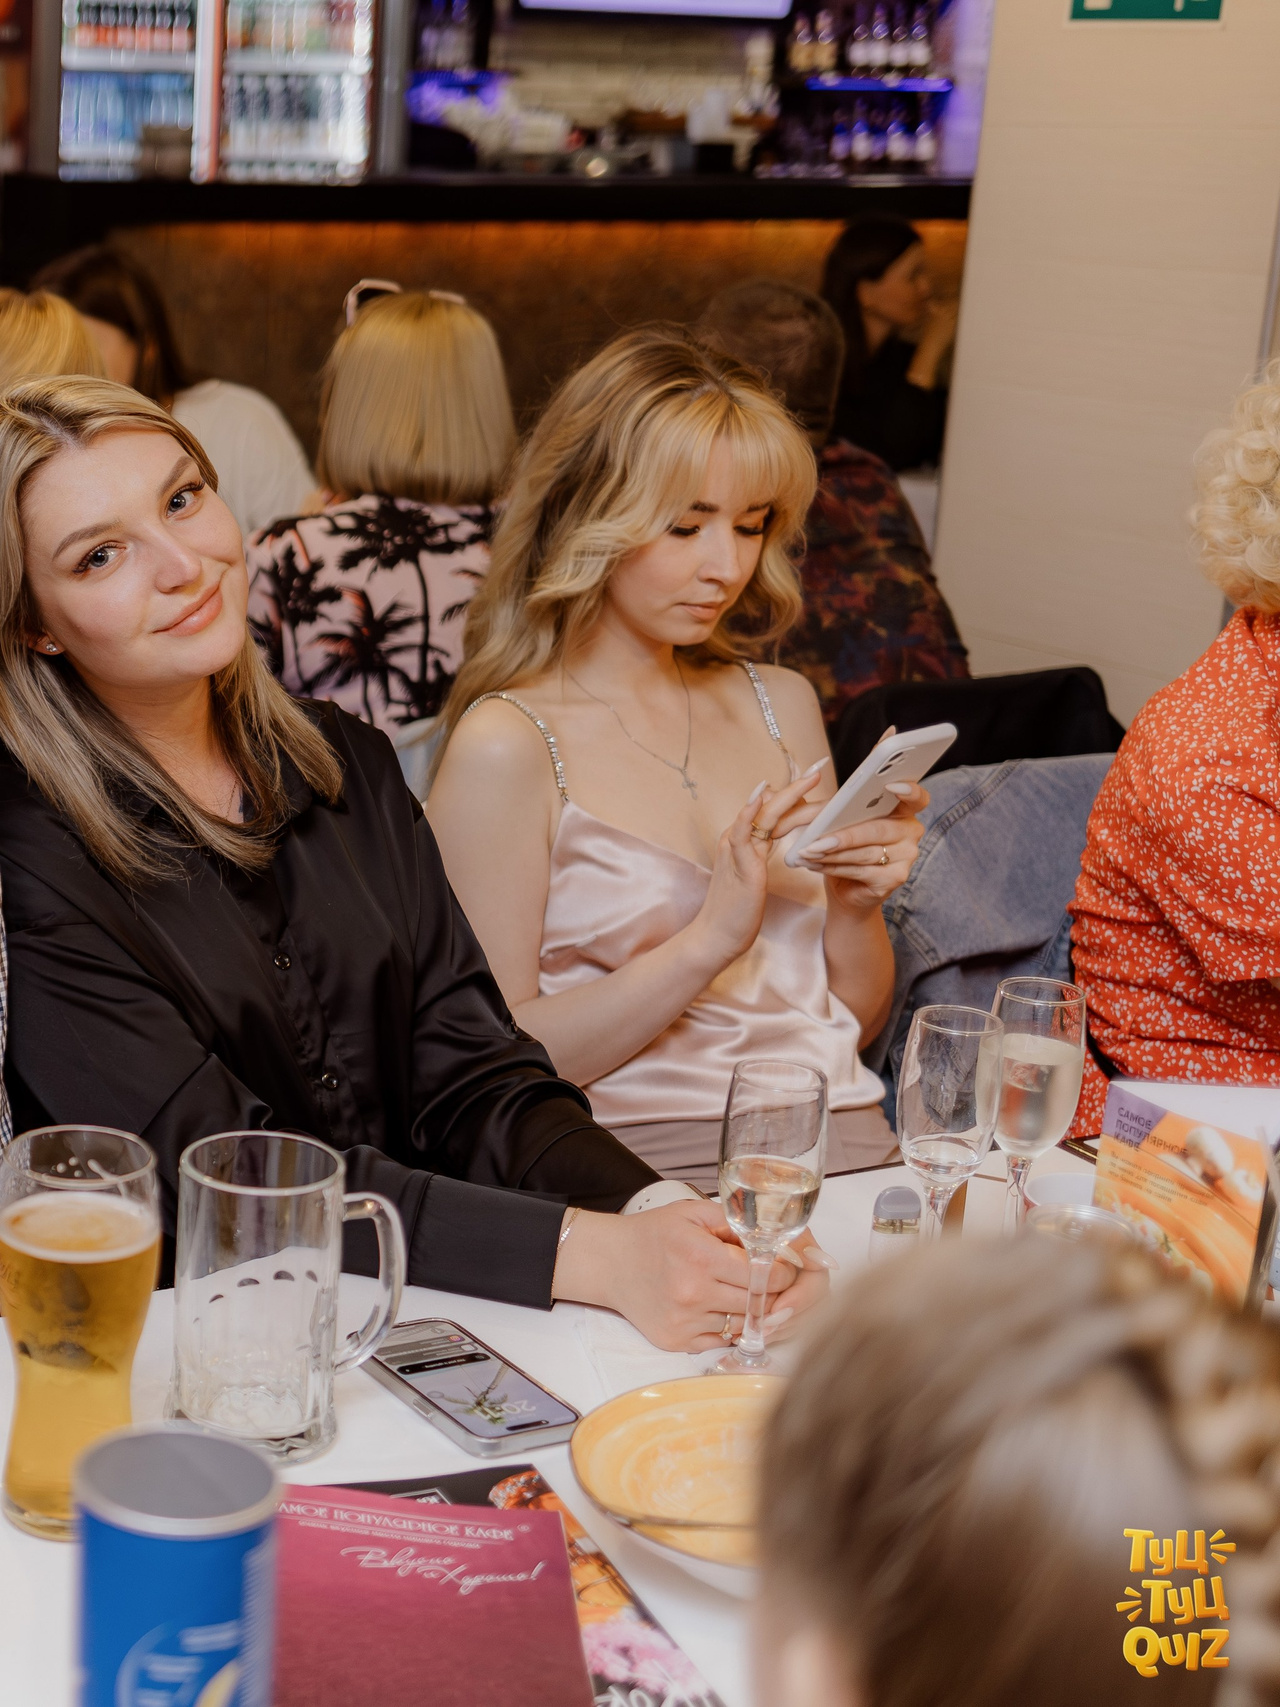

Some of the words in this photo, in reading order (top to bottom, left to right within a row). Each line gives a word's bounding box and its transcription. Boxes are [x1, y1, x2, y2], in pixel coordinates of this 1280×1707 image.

[1115, 1118, 1188, 1156] ПОПУЛЯРНОЕ
[1118, 1108, 1153, 1132] САМОЕ
[277, 1503, 328, 1518] АМОЕ
[464, 1526, 515, 1542] КАФЕ
